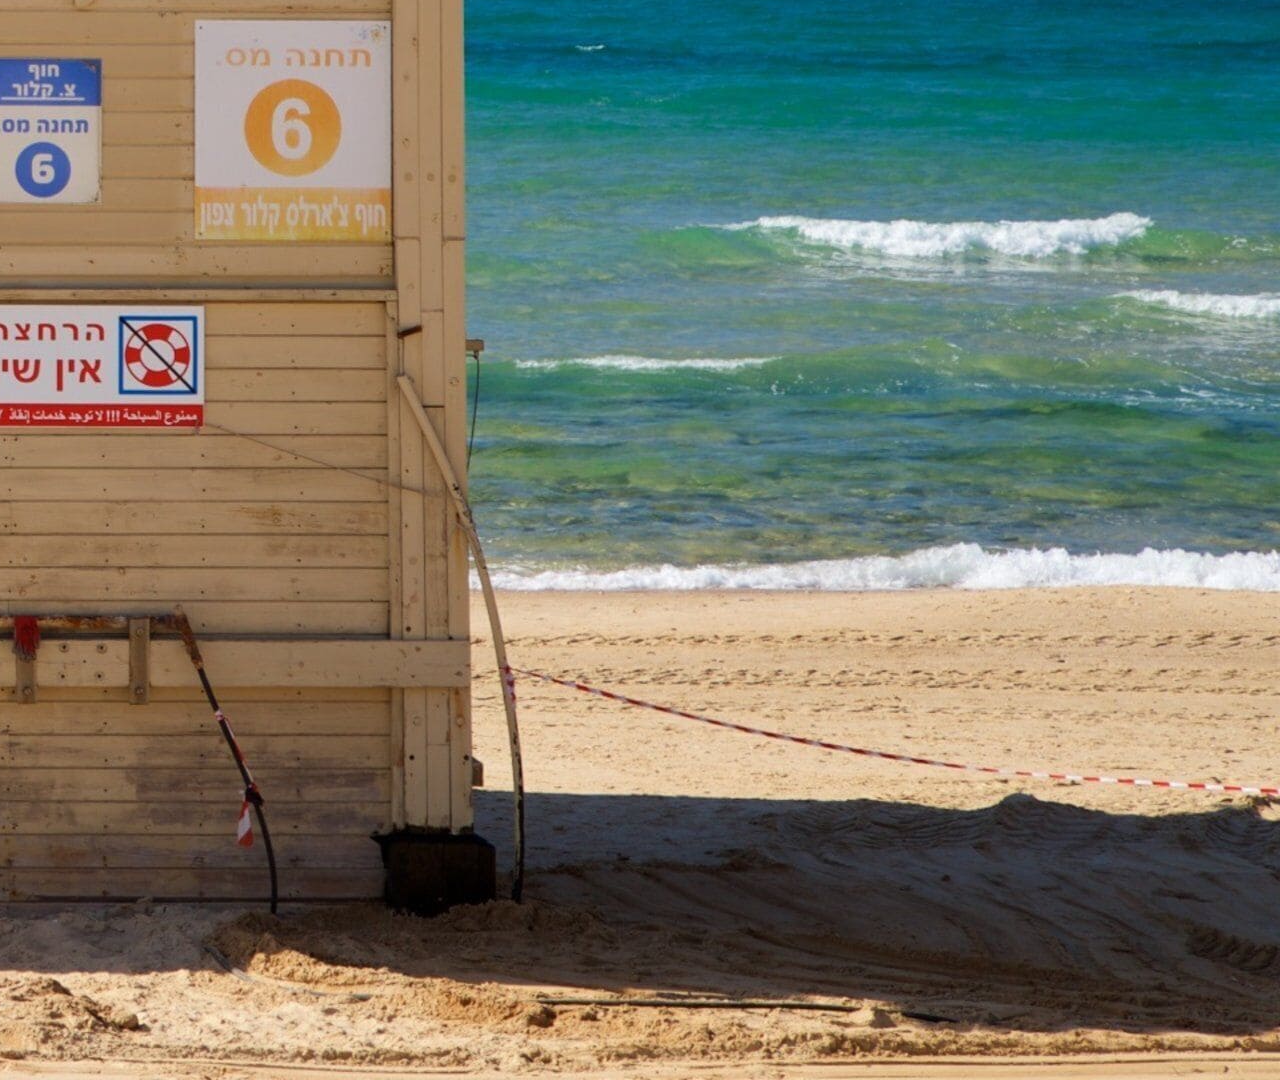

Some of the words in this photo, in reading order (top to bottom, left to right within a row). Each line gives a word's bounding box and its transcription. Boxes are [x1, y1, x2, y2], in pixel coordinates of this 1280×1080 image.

[286, 47, 371, 67] תחנה
[28, 64, 60, 80] חוף
[12, 81, 54, 99] קלור
[59, 83, 76, 97] צ.
[37, 119, 88, 133] תחנה
[271, 97, 312, 160] 6
[31, 153, 55, 185] 6
[200, 202, 234, 234] צפון
[241, 194, 280, 235] קלור
[355, 203, 386, 236] חוף
[56, 358, 102, 392] אין
[163, 410, 198, 425] ممنوع
